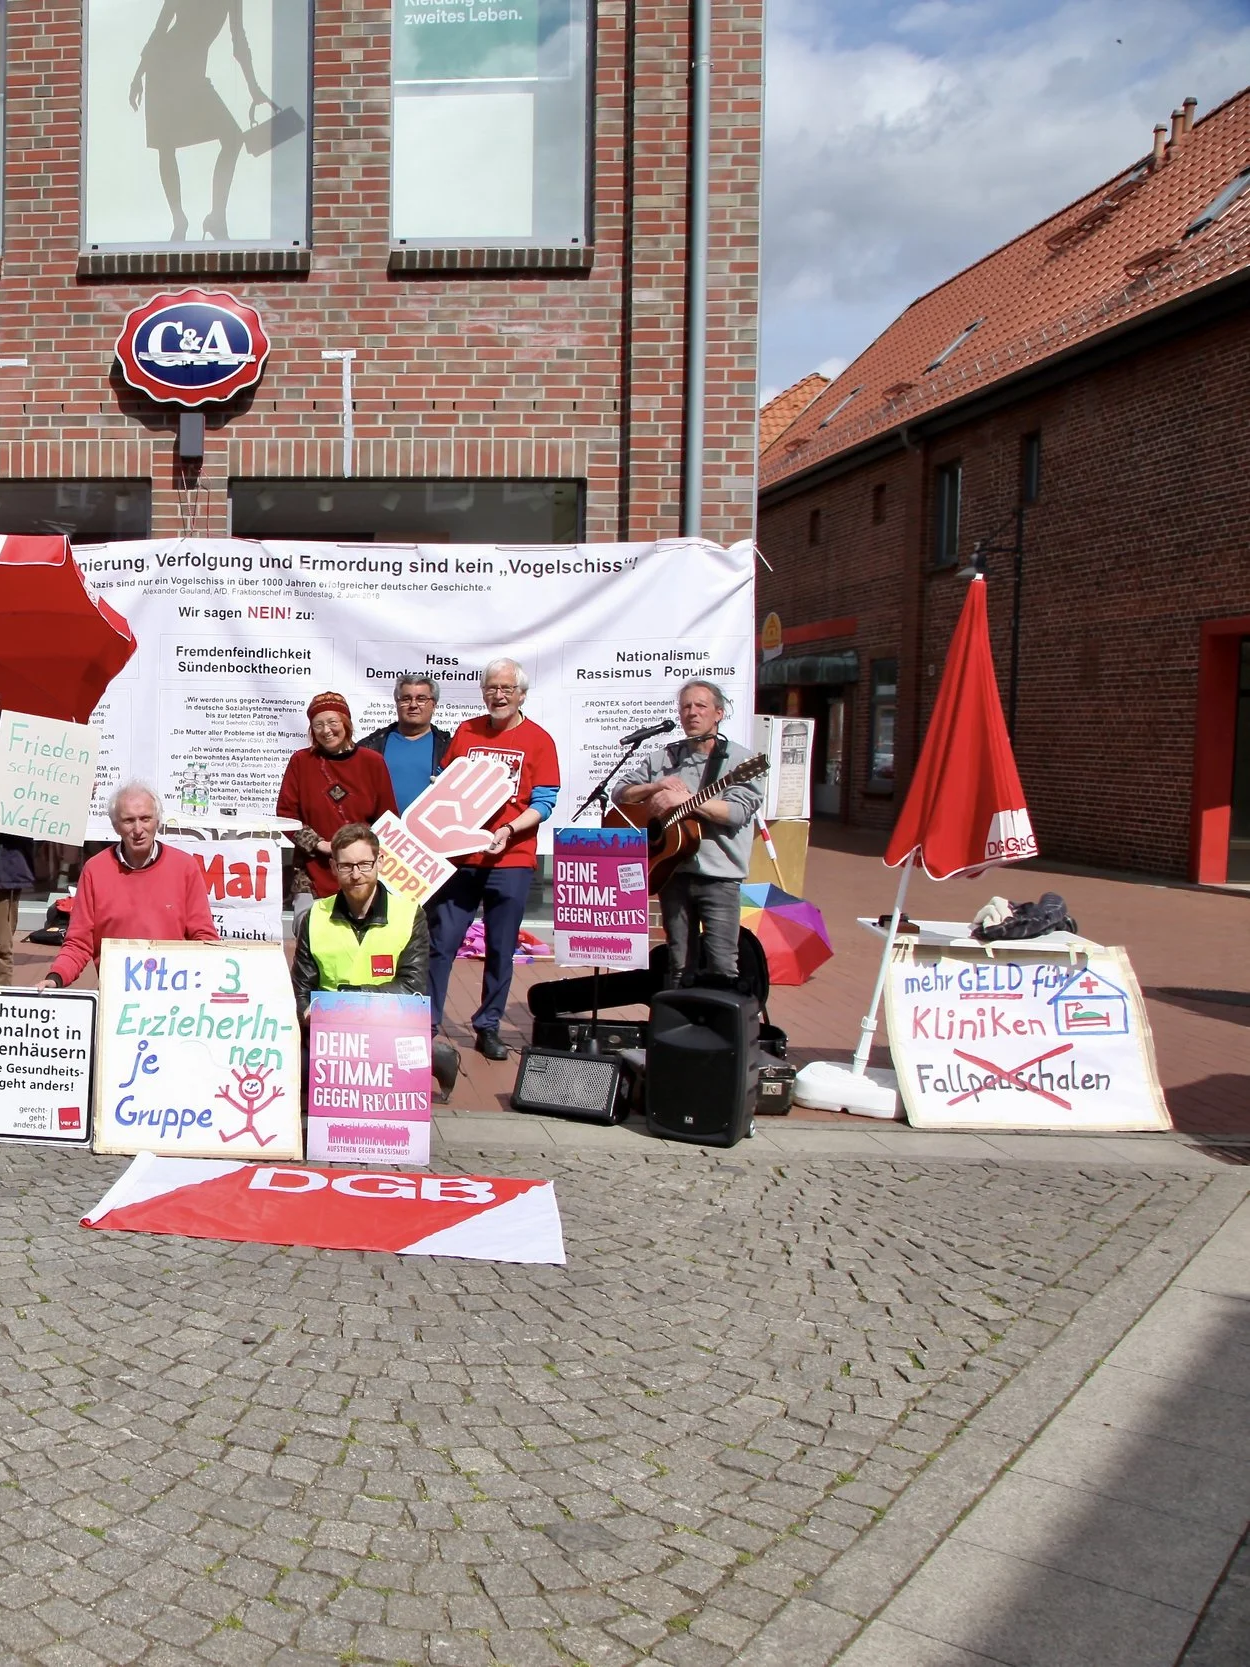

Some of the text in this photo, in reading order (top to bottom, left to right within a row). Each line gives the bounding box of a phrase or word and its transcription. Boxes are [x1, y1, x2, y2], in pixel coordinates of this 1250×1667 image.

[404, 8, 523, 25] zweites Leben.
[147, 320, 239, 367] C&A
[155, 552, 252, 572] Verfolgung
[259, 554, 293, 570] und
[299, 555, 403, 576] Ermordung
[409, 558, 449, 574] sind
[455, 558, 494, 574] kein
[116, 579, 136, 588] sind
[138, 579, 153, 587] nur
[155, 577, 169, 586] ein
[171, 576, 224, 588] Vogelschiss
[238, 576, 259, 587] über
[262, 577, 283, 588] 1000
[285, 578, 317, 589] Jahren
[382, 581, 429, 592] deutscher
[142, 588, 335, 600] Alexander Gauland, Fraktionschef Bundestag,
[178, 606, 315, 621] Wir sagen NEIN! zu:
[176, 645, 312, 661] Fremdenfeindlichkeit
[426, 654, 459, 666] Hass
[616, 650, 711, 663] Nationalismus
[178, 661, 312, 677] Sündenbocktheorien
[576, 667, 652, 680] Rassismus
[225, 705, 272, 713] Sozialsysteme
[260, 698, 306, 706] Zuwanderung
[621, 699, 675, 707] sofort beenden!
[584, 716, 628, 724] afrikanische
[597, 708, 630, 716] ersaufen,
[9, 722, 90, 764] Frieden
[231, 755, 280, 763] Asylantenheim
[6, 760, 81, 786] schaffen
[231, 779, 272, 787] Gastarbeiter
[242, 787, 272, 795] vielleicht
[13, 781, 61, 806] ohne
[0, 801, 71, 837] Waffen
[375, 821, 446, 884] MIETEN
[193, 849, 271, 902] Mai
[557, 861, 598, 884] DEINE
[557, 884, 617, 907] STIMME
[557, 907, 646, 927] GEGEN RECHTS
[232, 927, 268, 941] nicht
[124, 956, 242, 994] Kita: 3
[904, 962, 1072, 997] mehr GELD für
[116, 1003, 293, 1042] ErzieherIn-
[912, 1004, 1047, 1042] Kliniken
[65, 1024, 82, 1041] in
[316, 1031, 370, 1059] DEINE
[119, 1039, 161, 1089] je
[229, 1043, 284, 1070] nen
[6, 1062, 85, 1078] Gesundheits-
[314, 1058, 394, 1087] STIMME
[29, 1078, 75, 1093] anders!
[916, 1059, 1111, 1103] Fallpauschalen
[313, 1087, 428, 1113] GEGEN RECHTS
[18, 1105, 49, 1115] gerecht-
[28, 1114, 48, 1123] geht-
[114, 1094, 214, 1140] Gruppe
[12, 1121, 47, 1131] anders.de
[326, 1144, 411, 1156] AUFSTEHEN GEGEN RASSISMUS!
[248, 1166, 497, 1204] DGB
